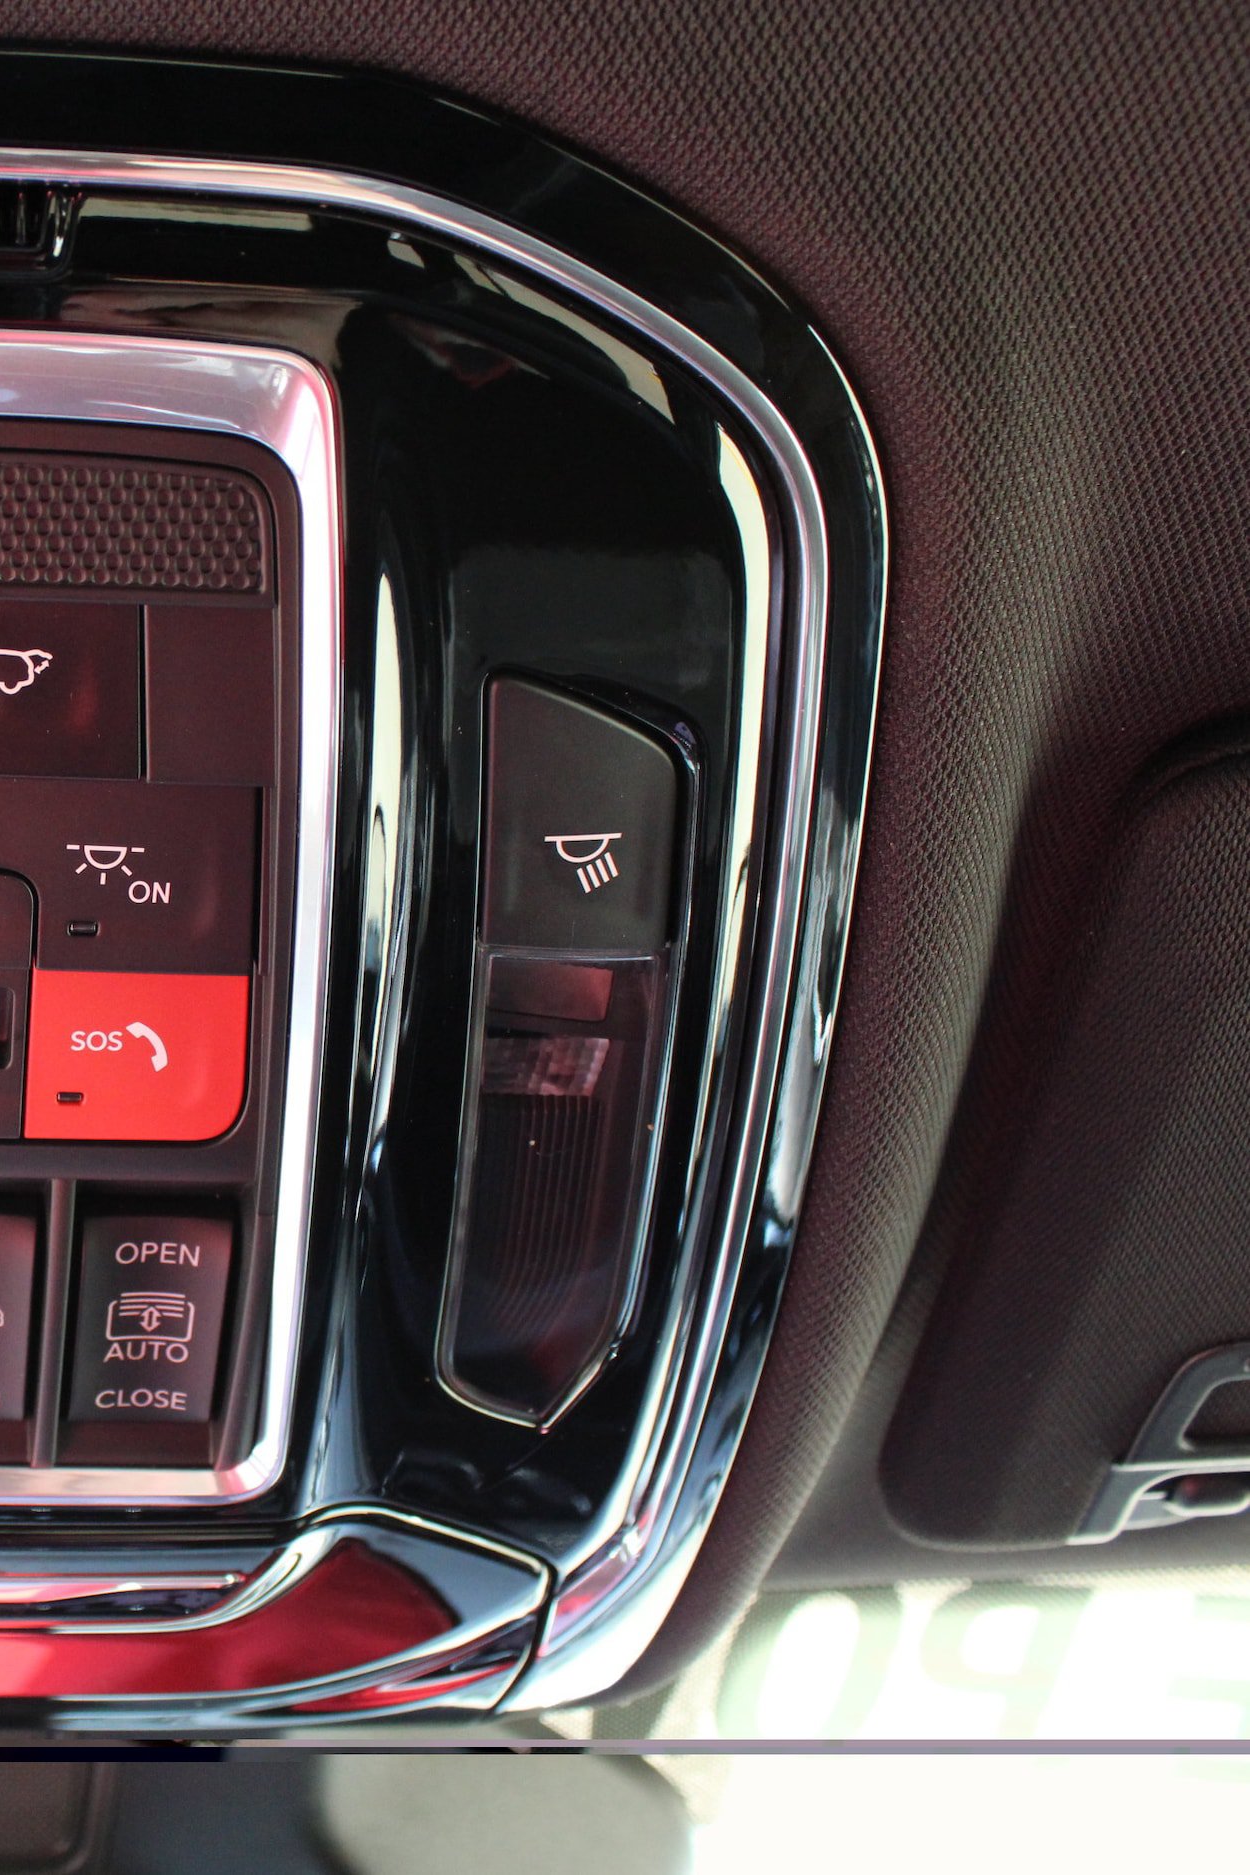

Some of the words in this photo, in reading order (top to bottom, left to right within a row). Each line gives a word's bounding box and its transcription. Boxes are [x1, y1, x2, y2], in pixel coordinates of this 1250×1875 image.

[128, 880, 170, 903] ON
[70, 1031, 122, 1052] SOS
[115, 1242, 200, 1267] OPEN
[103, 1341, 189, 1363] AUTO
[94, 1389, 187, 1411] CLOSE
